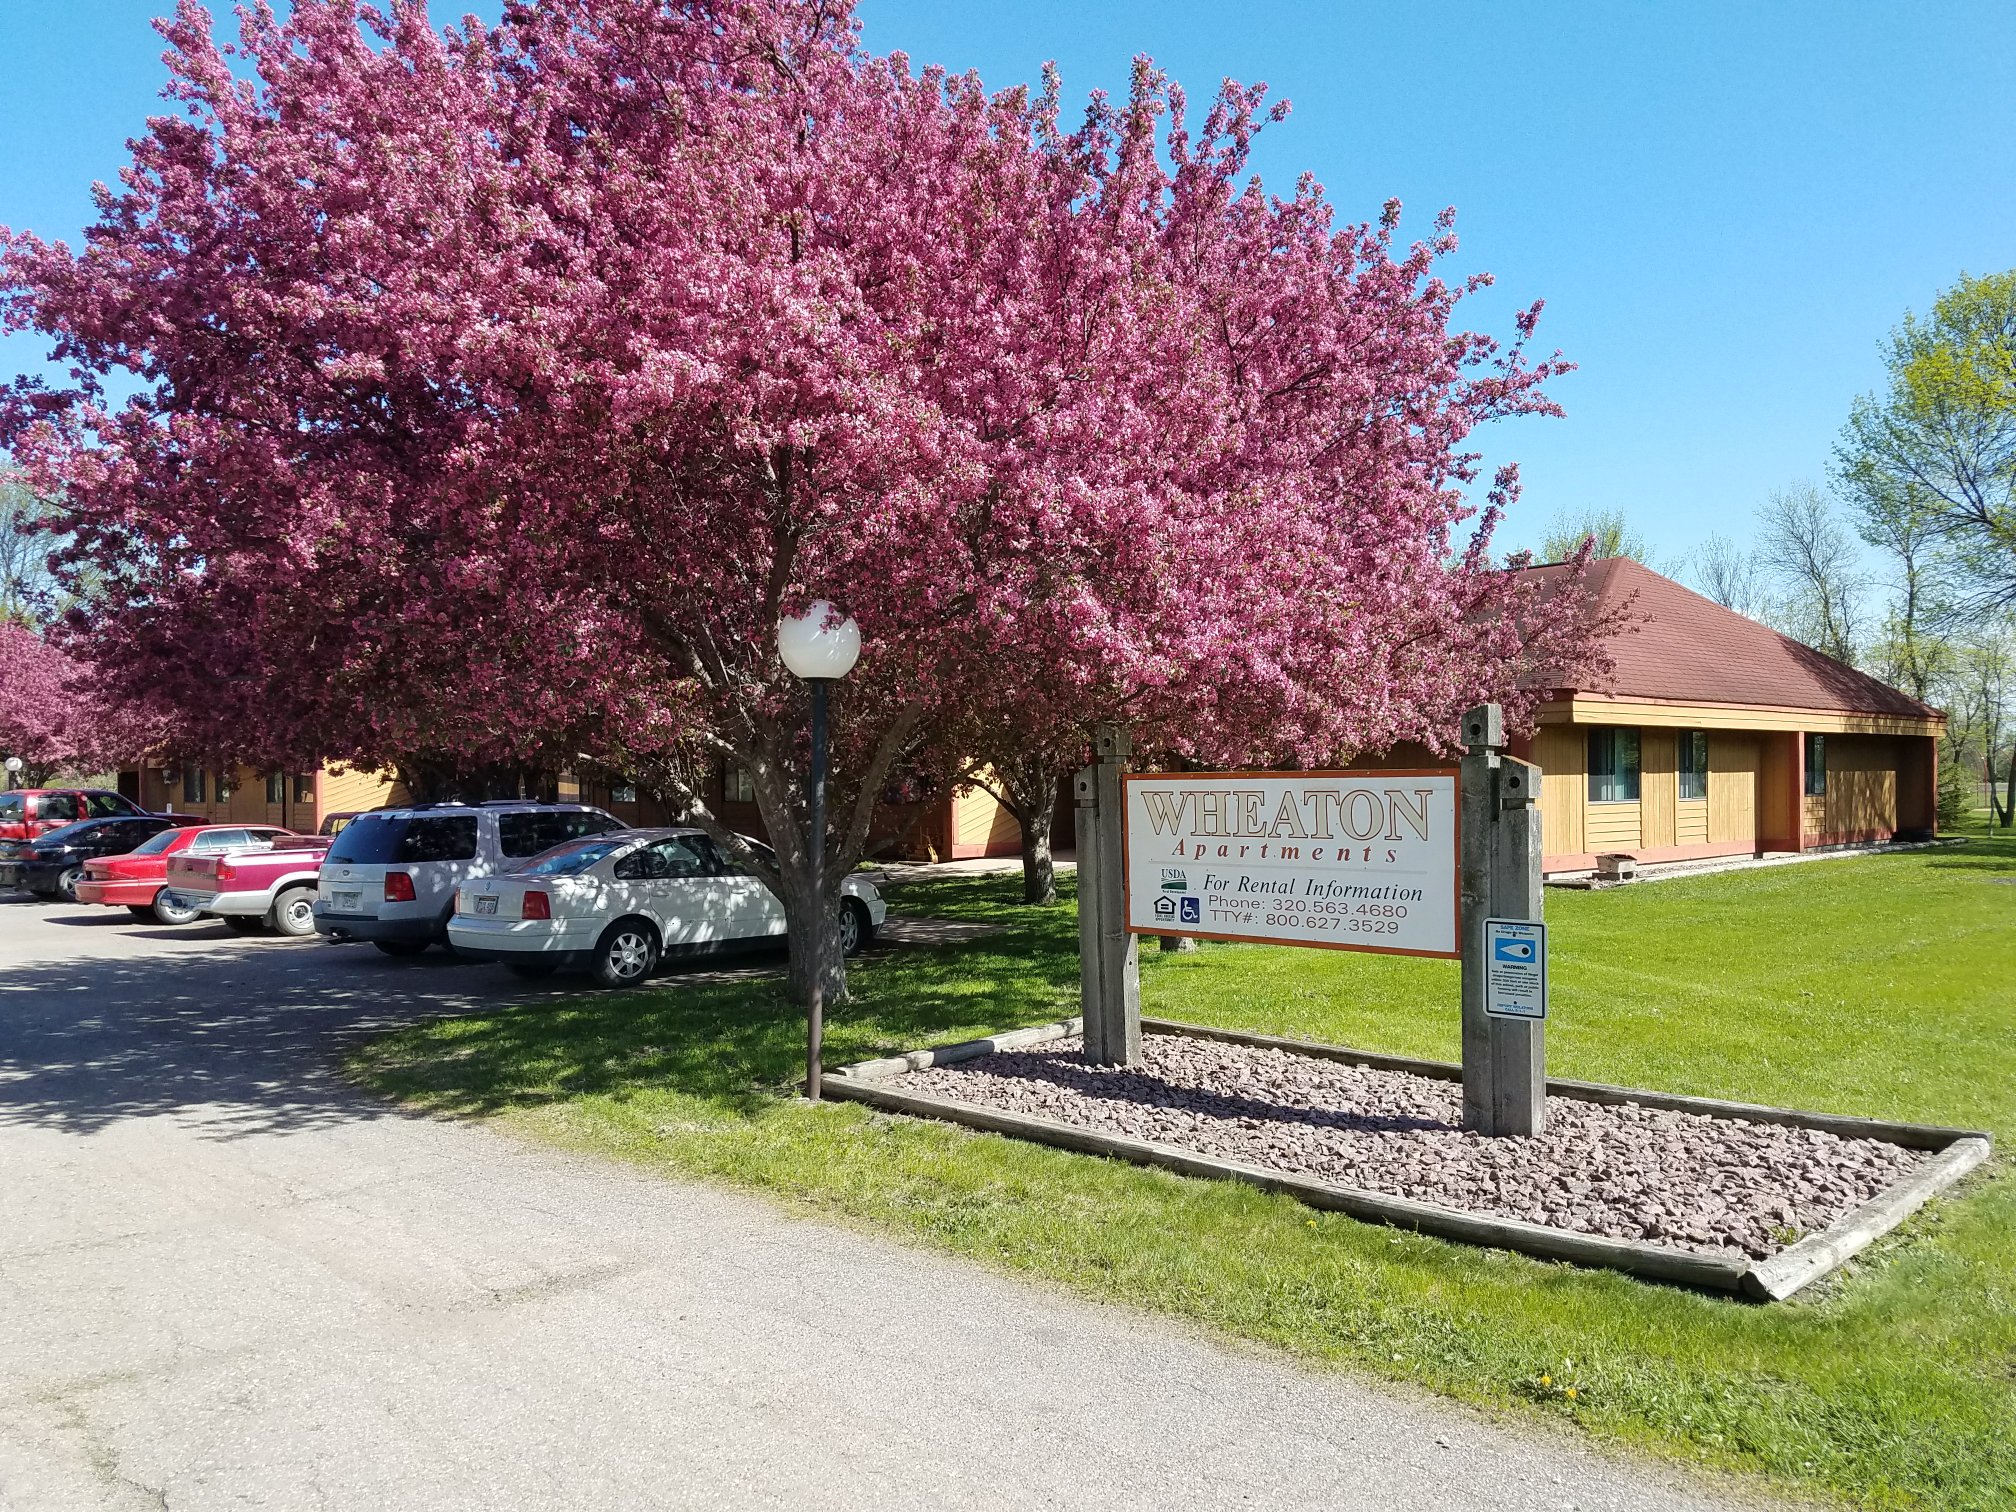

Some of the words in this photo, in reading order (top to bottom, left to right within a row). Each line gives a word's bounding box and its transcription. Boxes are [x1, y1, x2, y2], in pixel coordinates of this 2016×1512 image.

[1141, 788, 1433, 841] WHEATON
[1171, 838, 1397, 863] Apartments
[1161, 868, 1187, 879] USDA
[1203, 873, 1230, 891] For
[1237, 875, 1296, 895] Rental
[1304, 878, 1423, 902] Information
[1208, 894, 1265, 909] Phone:
[1272, 898, 1408, 919] 320.563.4680
[1209, 909, 1259, 924] TTY#:
[1265, 913, 1399, 934] 800.627.3529
